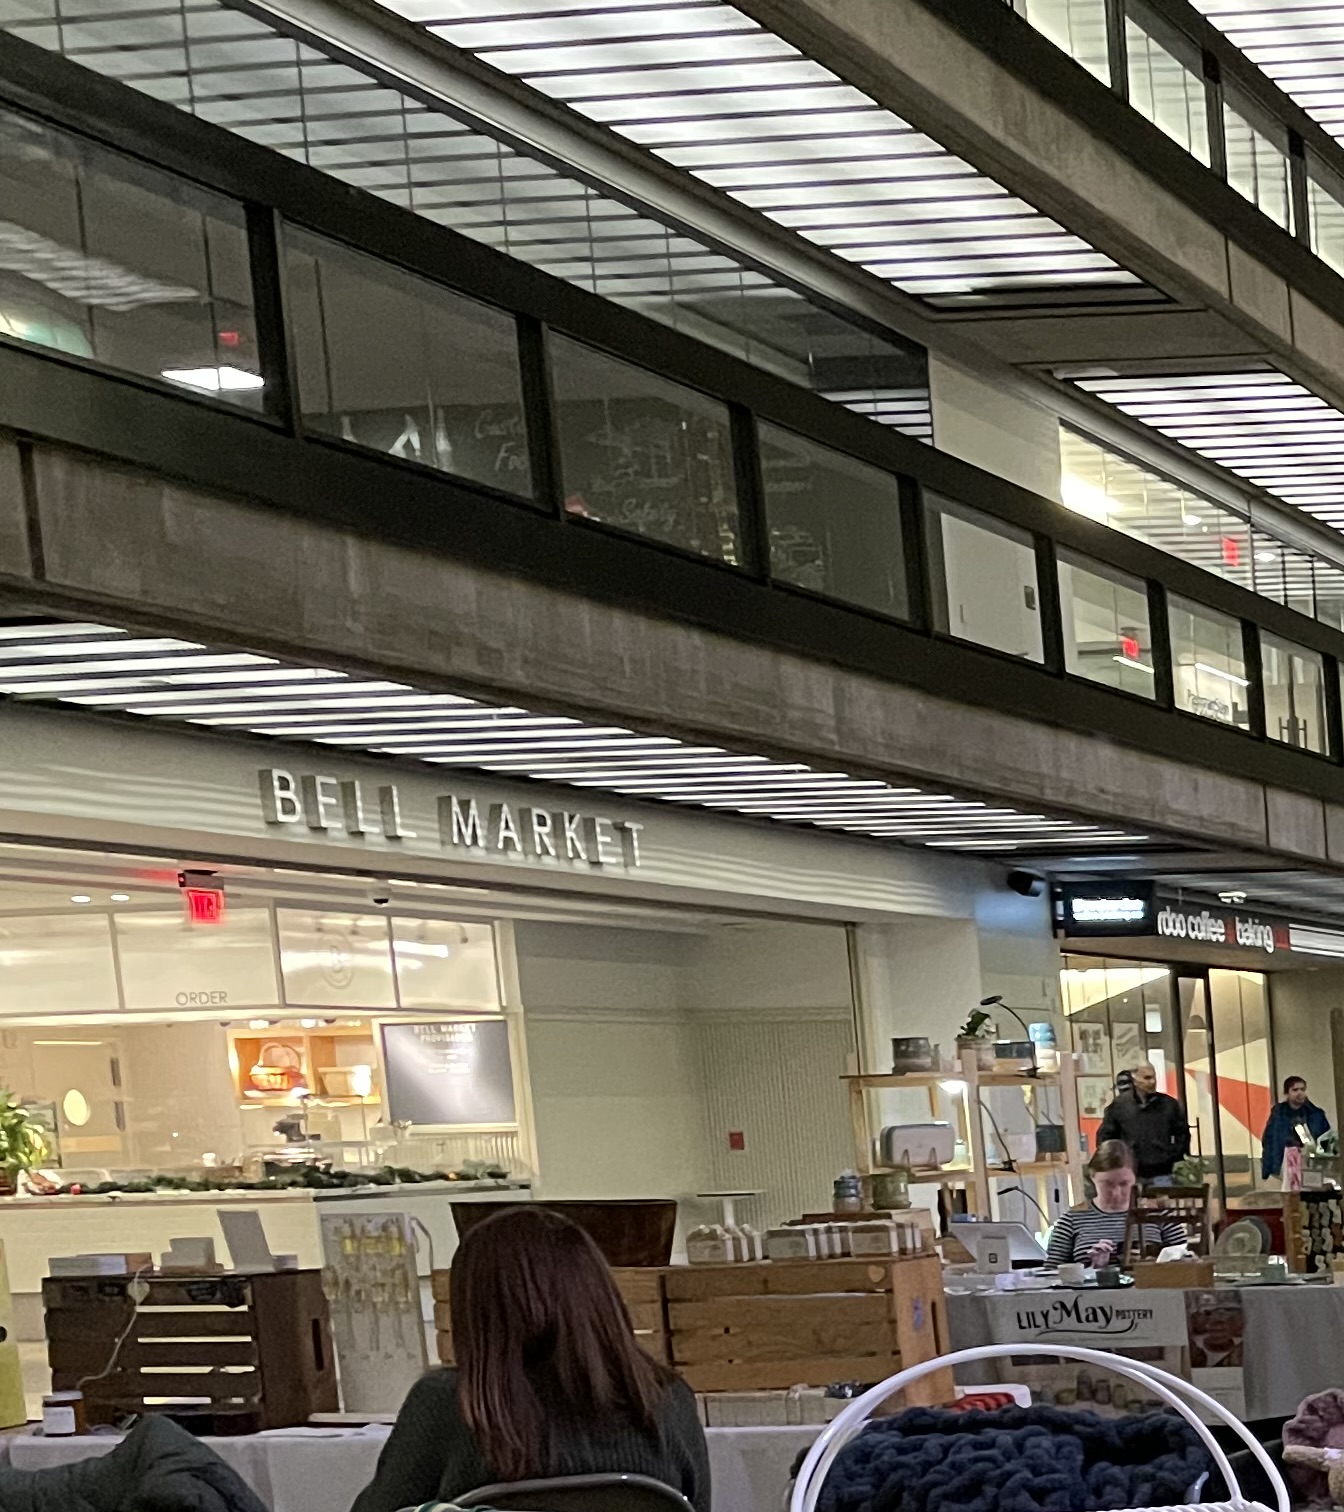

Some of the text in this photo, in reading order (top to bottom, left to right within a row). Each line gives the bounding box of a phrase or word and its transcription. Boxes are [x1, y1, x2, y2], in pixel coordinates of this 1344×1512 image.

[258, 768, 644, 867] BELL MARKET
[1187, 911, 1226, 943] coffee
[1235, 916, 1275, 954] baking
[175, 990, 228, 1006] ORDER
[1016, 1294, 1153, 1330] LILY May POTTERY
